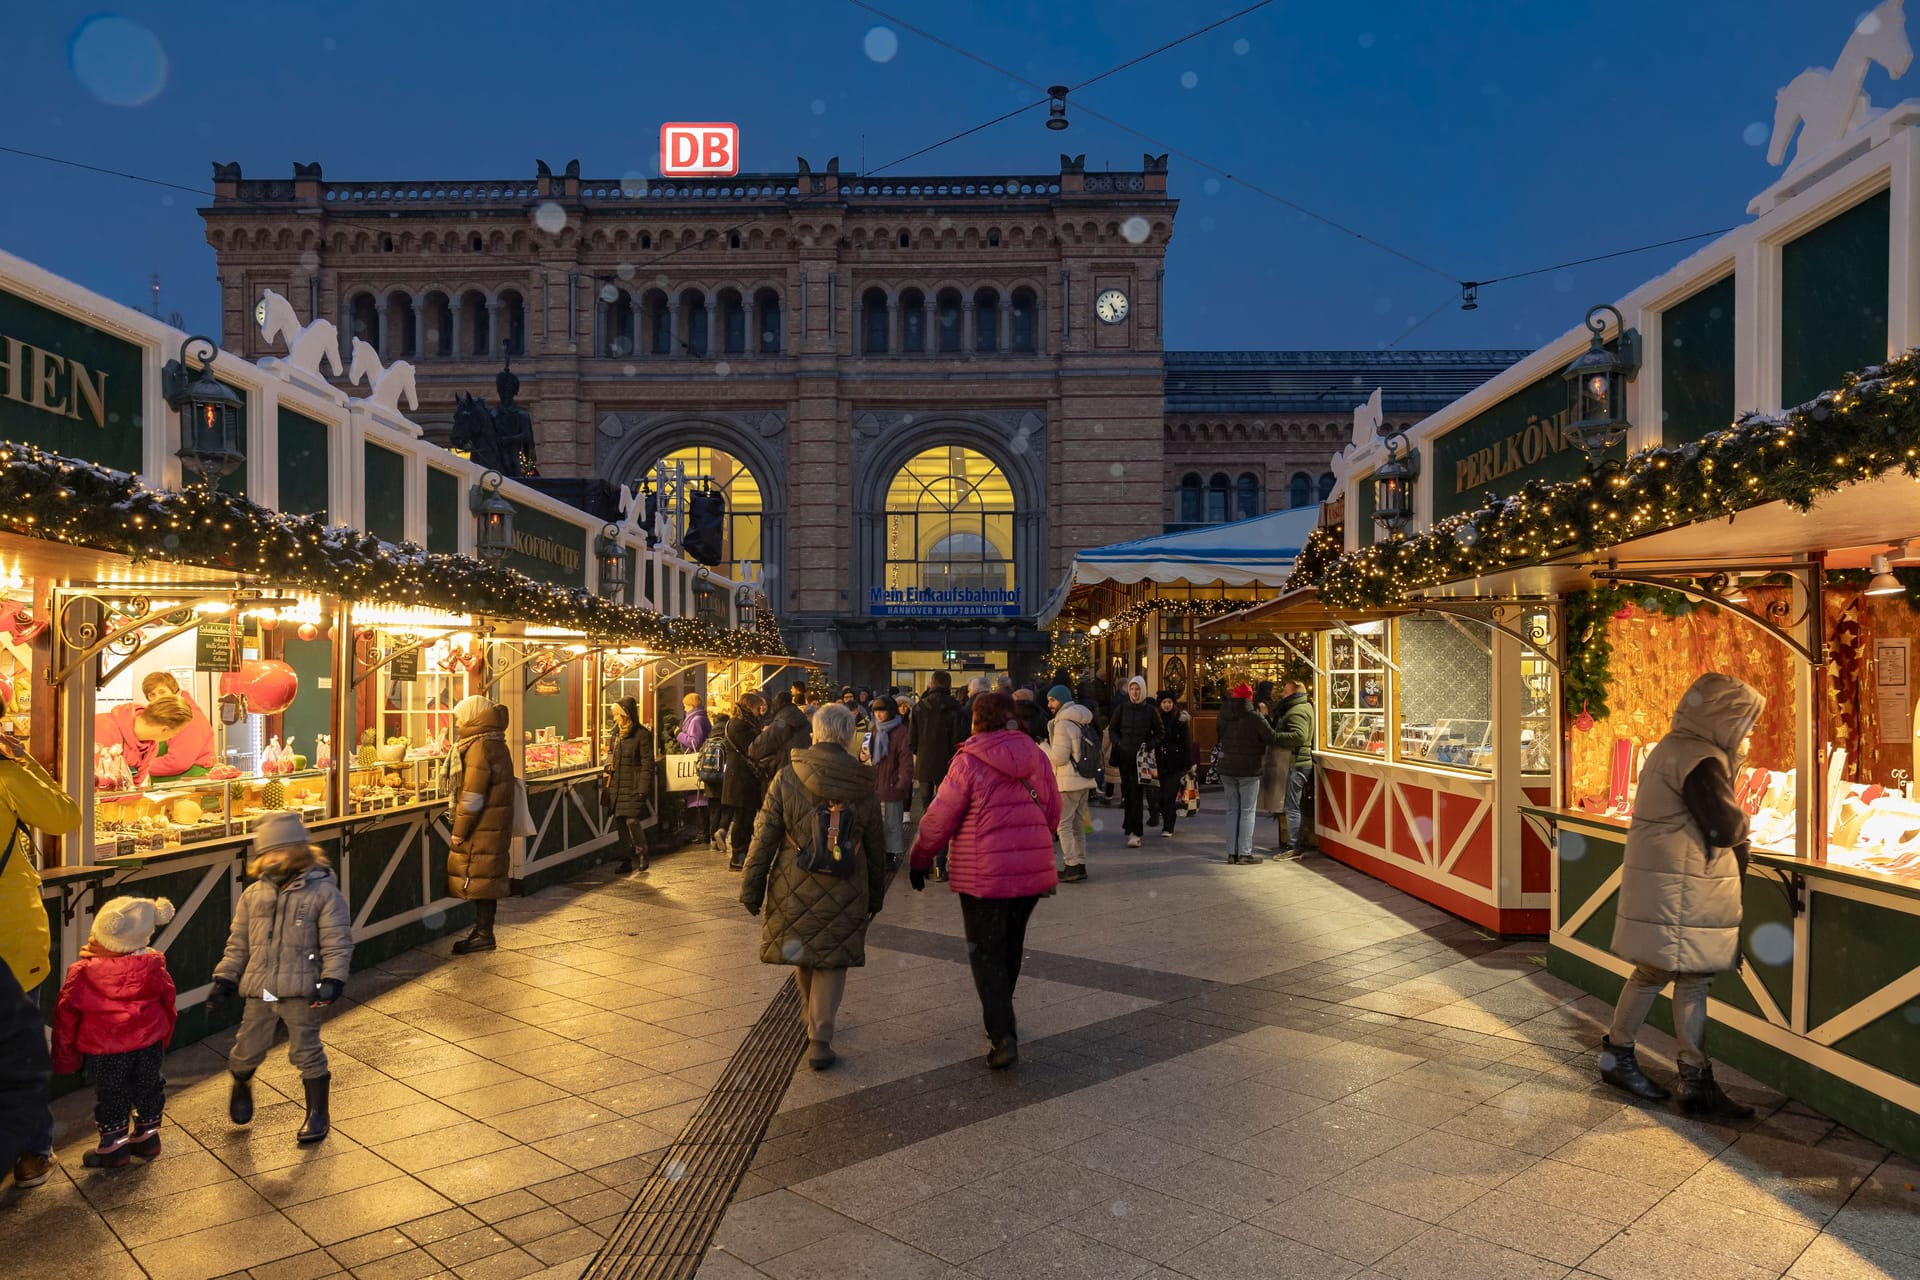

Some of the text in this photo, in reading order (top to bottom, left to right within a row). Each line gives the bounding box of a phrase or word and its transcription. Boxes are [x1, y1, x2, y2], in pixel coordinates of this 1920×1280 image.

[672, 132, 729, 168] DB
[1456, 409, 1572, 494] PERLKÖNI
[512, 529, 580, 570] KOFRÜCHTE
[870, 586, 1022, 602] Mein Einkaufsbahnhof
[887, 606, 1004, 615] HANNOVER HAUPTBAHNHOF
